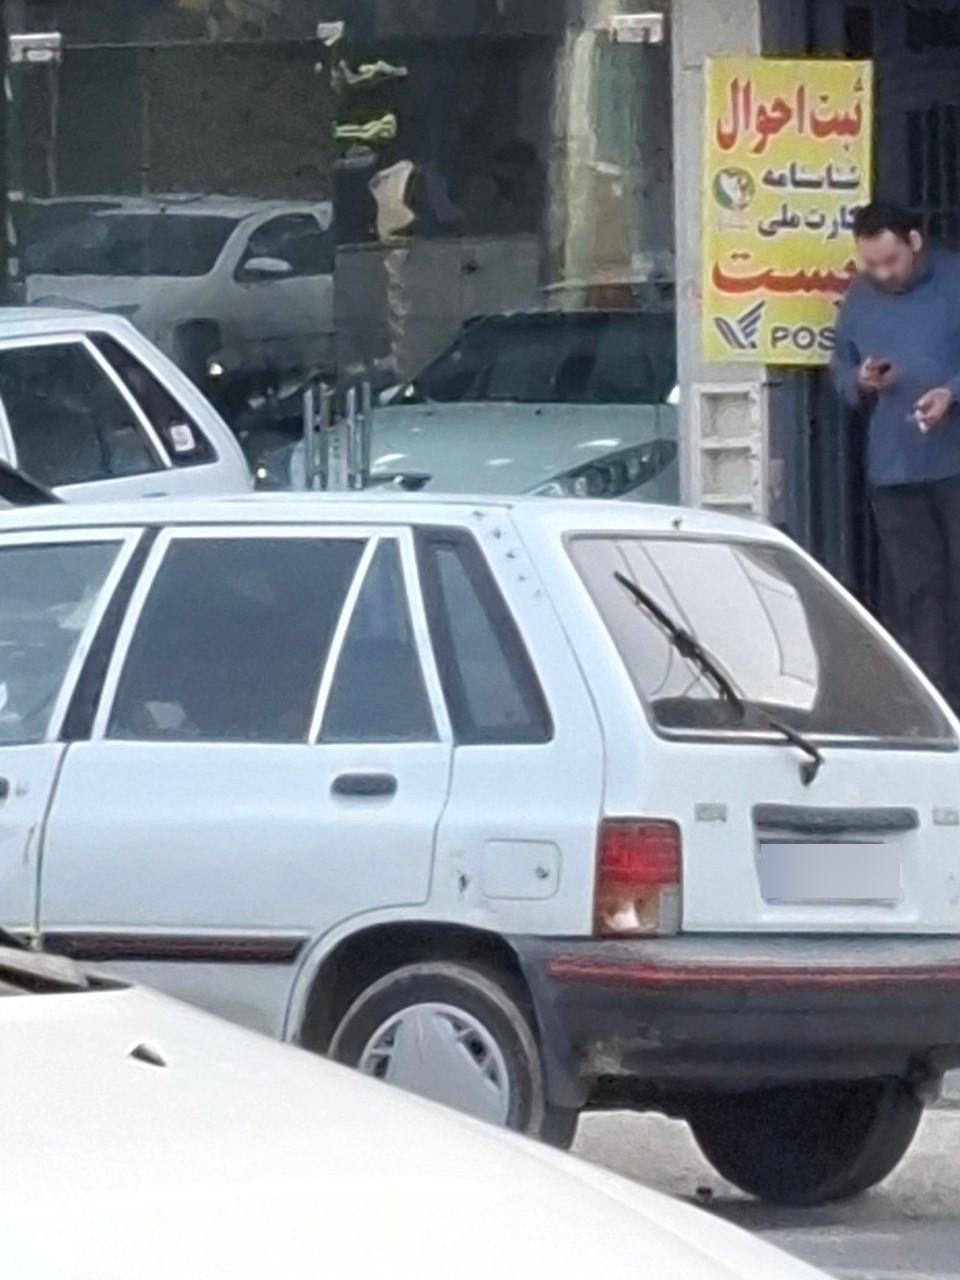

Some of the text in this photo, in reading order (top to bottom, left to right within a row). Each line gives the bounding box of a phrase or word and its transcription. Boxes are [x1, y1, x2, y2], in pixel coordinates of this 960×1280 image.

[716, 76, 806, 155] احوال
[757, 203, 801, 238] ملی
[770, 325, 836, 352] POS
